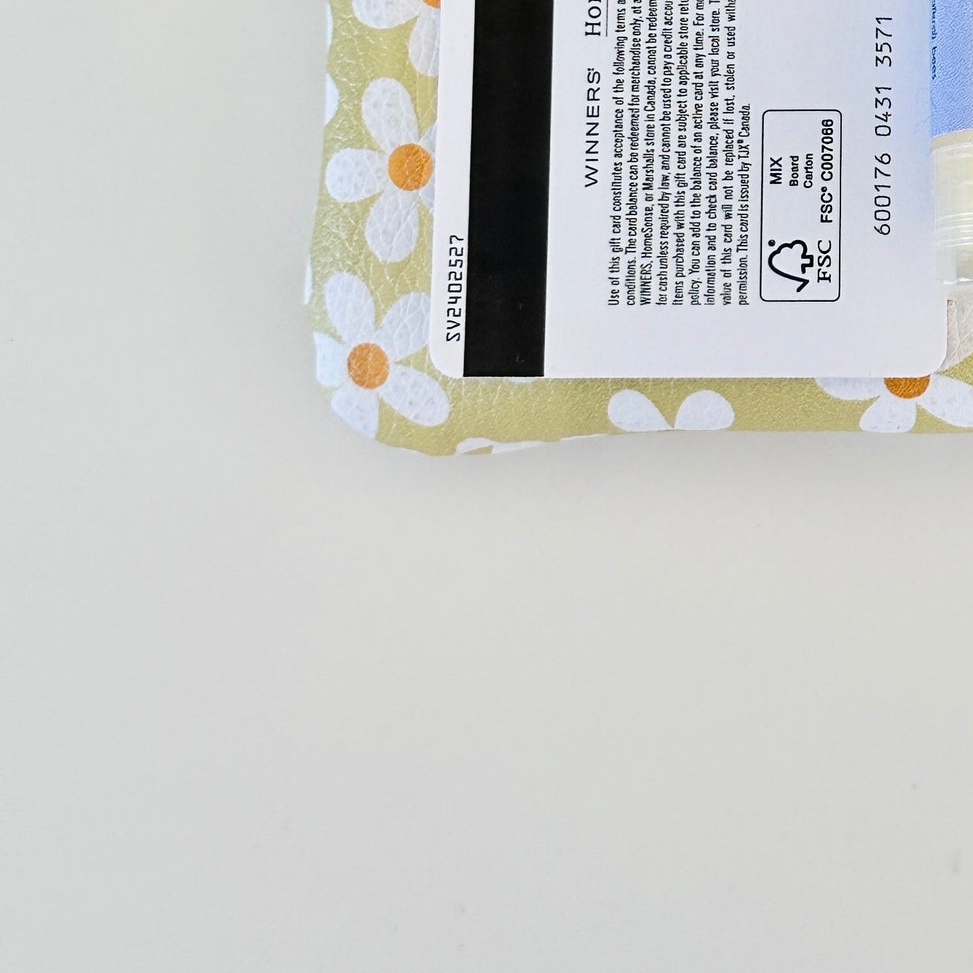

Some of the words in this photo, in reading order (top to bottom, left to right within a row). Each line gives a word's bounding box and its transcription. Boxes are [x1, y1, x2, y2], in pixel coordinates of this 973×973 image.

[630, 4, 642, 14] at
[692, 11, 705, 26] For
[614, 7, 626, 33] terms
[677, 16, 689, 39] store
[644, 31, 657, 44] be
[660, 26, 673, 52] credit
[707, 34, 720, 55] local
[723, 25, 736, 47] used
[874, 16, 893, 67] 3571
[611, 35, 628, 75] following
[627, 36, 642, 92] merchandise
[645, 45, 657, 75] cannot
[675, 40, 690, 86] applicable
[694, 52, 707, 68] any
[725, 50, 736, 59] or
[662, 59, 675, 76] pay
[691, 70, 704, 79] at
[709, 58, 722, 77] your
[722, 62, 735, 90] stolen
[611, 77, 625, 93] the
[660, 76, 672, 86] to
[690, 81, 704, 101] card
[707, 79, 719, 99] visit
[611, 95, 624, 105] of
[626, 93, 640, 106] for
[659, 87, 672, 109] used
[675, 87, 688, 97] to
[643, 112, 655, 122] in
[658, 109, 672, 121] be
[674, 99, 690, 132] subject
[691, 102, 704, 129] active
[705, 100, 721, 130] please
[874, 85, 892, 136] 0431
[611, 107, 626, 158] acceptance
[626, 107, 640, 150] redeemed
[643, 122, 656, 146] store
[659, 122, 671, 153] cannot
[692, 131, 703, 142] an
[676, 133, 687, 148] are
[689, 144, 703, 154] of
[721, 128, 736, 166] replaced
[819, 118, 834, 181] C007066
[625, 151, 639, 163] be
[657, 153, 671, 170] and
[673, 150, 687, 170] card
[736, 160, 752, 172] by
[628, 163, 639, 180] can
[641, 147, 655, 190] Marshalls
[688, 155, 702, 190] balance
[720, 169, 734, 181] be
[768, 156, 783, 184] MIX
[788, 154, 799, 186] Board
[802, 152, 814, 188] Carton
[610, 161, 623, 212] constitutes
[673, 171, 688, 188] gift
[704, 171, 718, 191] card
[736, 172, 750, 202] issued
[624, 181, 639, 216] balance
[644, 191, 654, 202] or
[656, 190, 672, 201] by
[672, 189, 686, 207] this
[688, 192, 702, 207] the
[721, 184, 734, 200] not
[873, 152, 891, 235] 600176
[689, 209, 702, 219] to
[704, 193, 718, 219] check
[720, 203, 733, 220] will
[737, 203, 749, 211] is
[609, 214, 622, 234] card
[624, 216, 638, 236] card
[656, 202, 672, 239] required
[672, 208, 686, 230] with
[688, 220, 701, 238] add
[704, 221, 717, 231] to
[736, 212, 749, 232] card
[704, 234, 717, 251] and
[720, 223, 733, 243] card
[735, 233, 749, 253] This
[608, 236, 624, 253] gift
[623, 237, 637, 255] The
[655, 240, 669, 269] unless
[671, 231, 686, 278] purchased
[690, 239, 701, 256] can
[607, 255, 621, 273] this
[719, 246, 732, 264] this
[816, 239, 832, 283] FSC
[687, 257, 701, 275] You
[719, 268, 732, 278] of
[445, 234, 464, 342] SV2402527
[607, 276, 620, 286] of
[655, 269, 668, 291] cash
[702, 253, 717, 305] information
[607, 288, 620, 305] Use
[654, 292, 668, 306] for
[671, 279, 684, 305] Items
[718, 281, 732, 305] value
